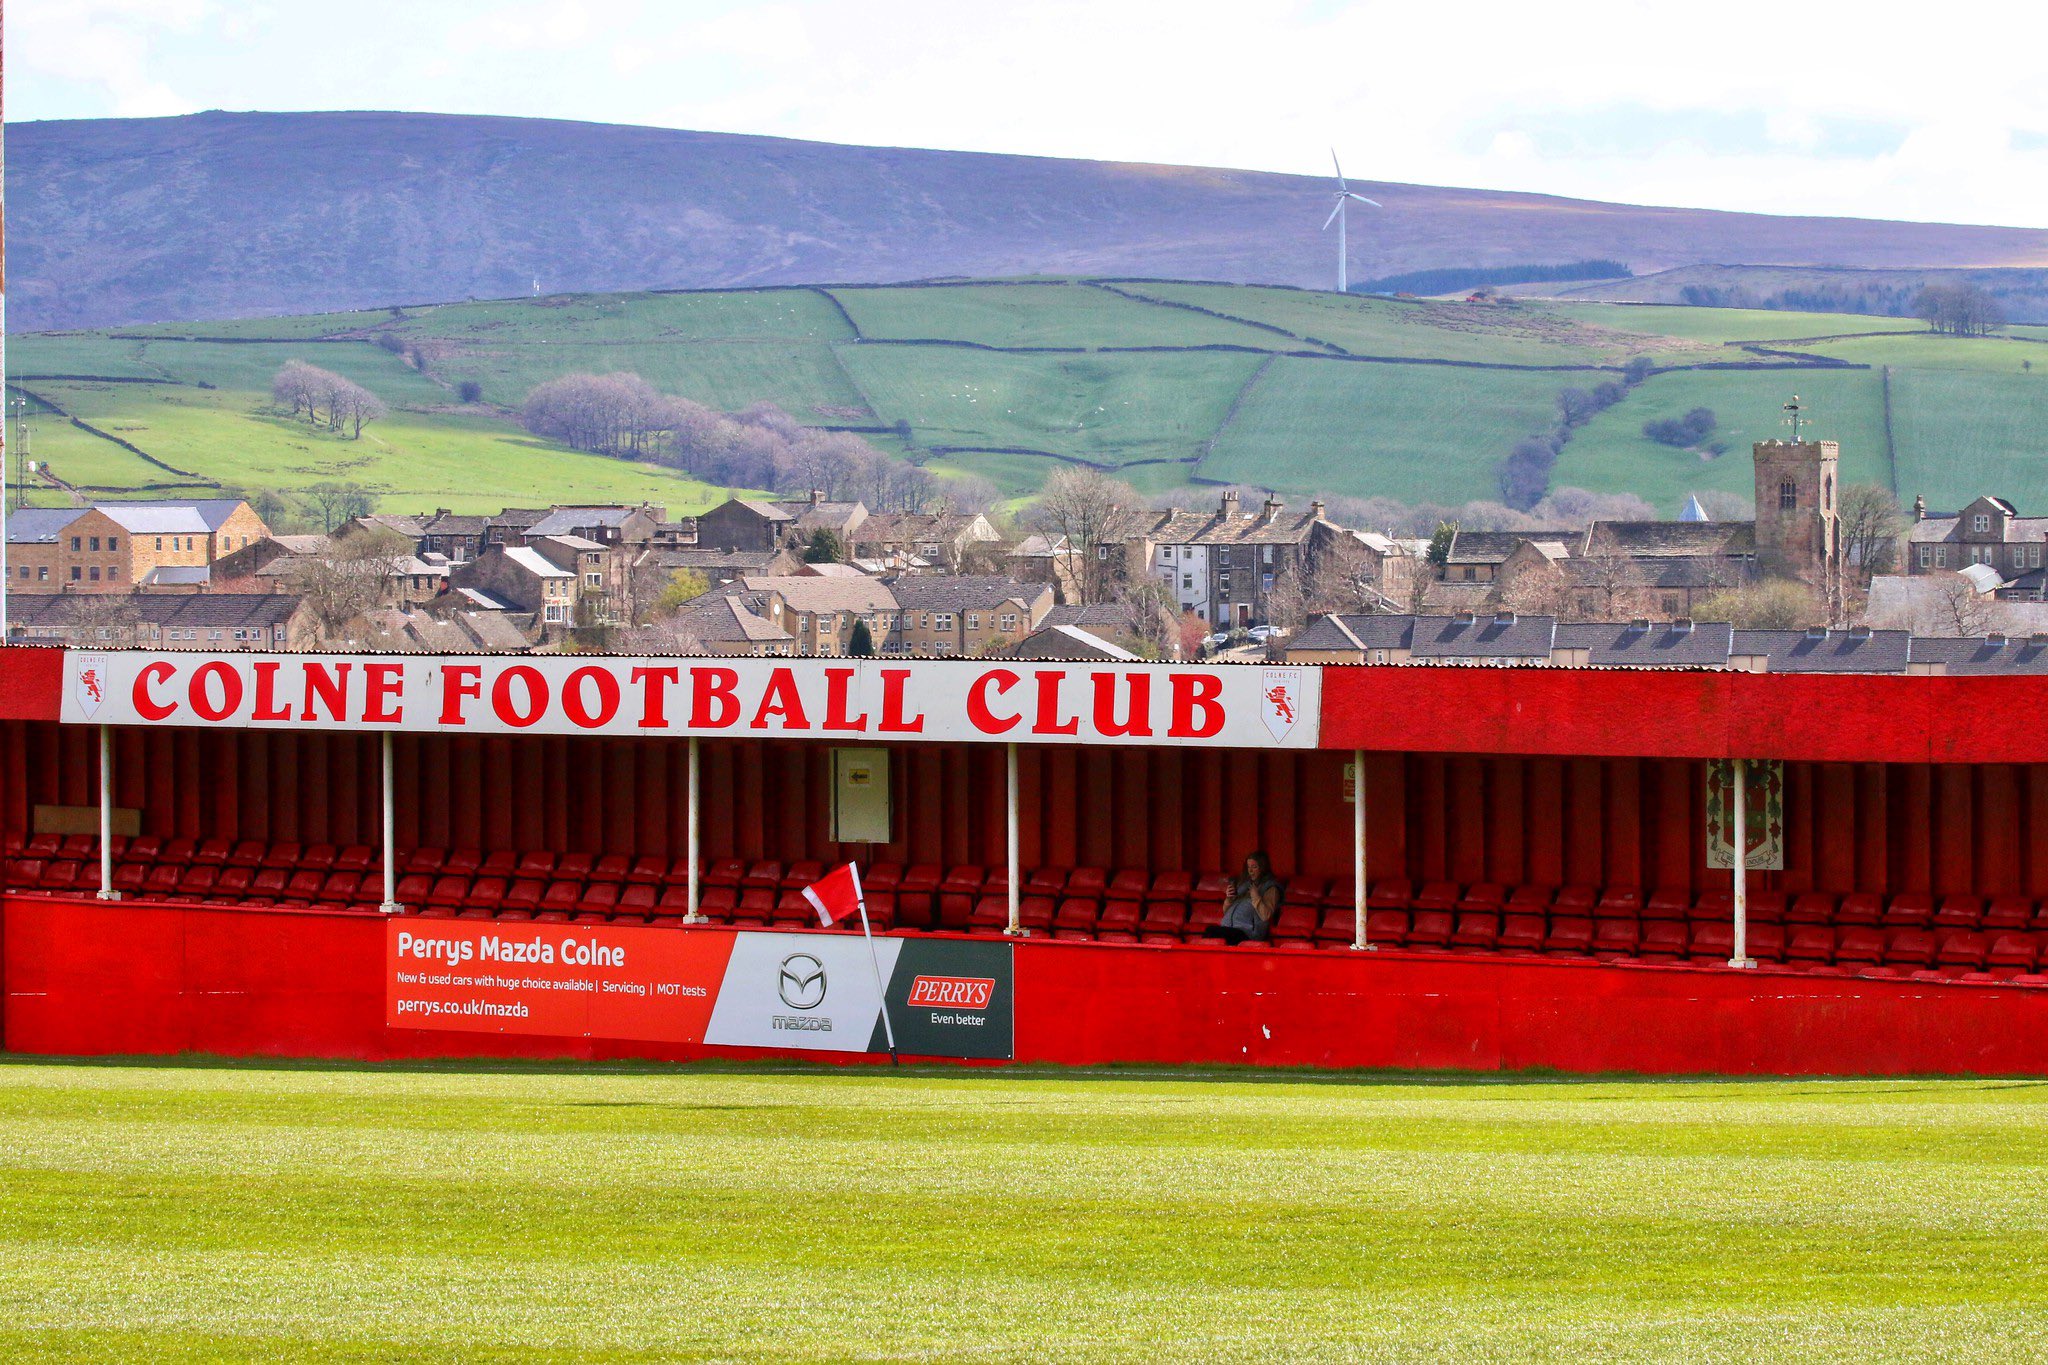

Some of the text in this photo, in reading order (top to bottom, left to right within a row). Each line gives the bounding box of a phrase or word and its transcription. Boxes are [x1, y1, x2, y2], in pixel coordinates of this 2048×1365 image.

[133, 661, 1226, 739] COLNE FOOTBALL CLUB
[398, 932, 625, 967] Perrys Mazda Colne
[397, 972, 707, 997] New & used cars with huge choice available Servicing MOT tests
[913, 981, 988, 1004] PERRYS
[397, 999, 529, 1018] perrys.co.uk/mazda
[931, 1012, 986, 1026] Even better
